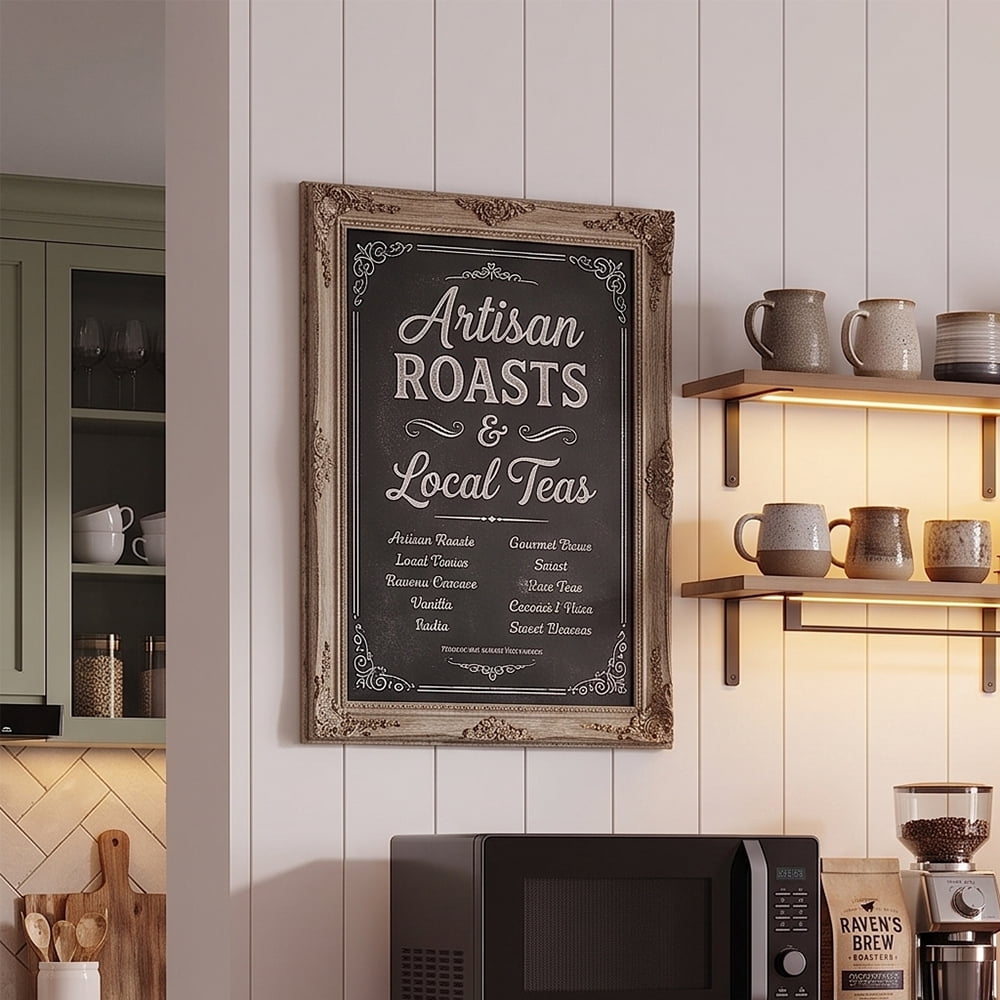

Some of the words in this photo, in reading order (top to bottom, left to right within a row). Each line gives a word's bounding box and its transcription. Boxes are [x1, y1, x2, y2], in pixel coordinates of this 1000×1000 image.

[398, 286, 584, 349] Artisan
[394, 352, 588, 409] ROASTS
[478, 414, 508, 447] &
[385, 451, 501, 509] Local
[507, 457, 597, 506] Teas
[840, 916, 903, 934] RAVEN'S
[853, 934, 894, 951] BREW
